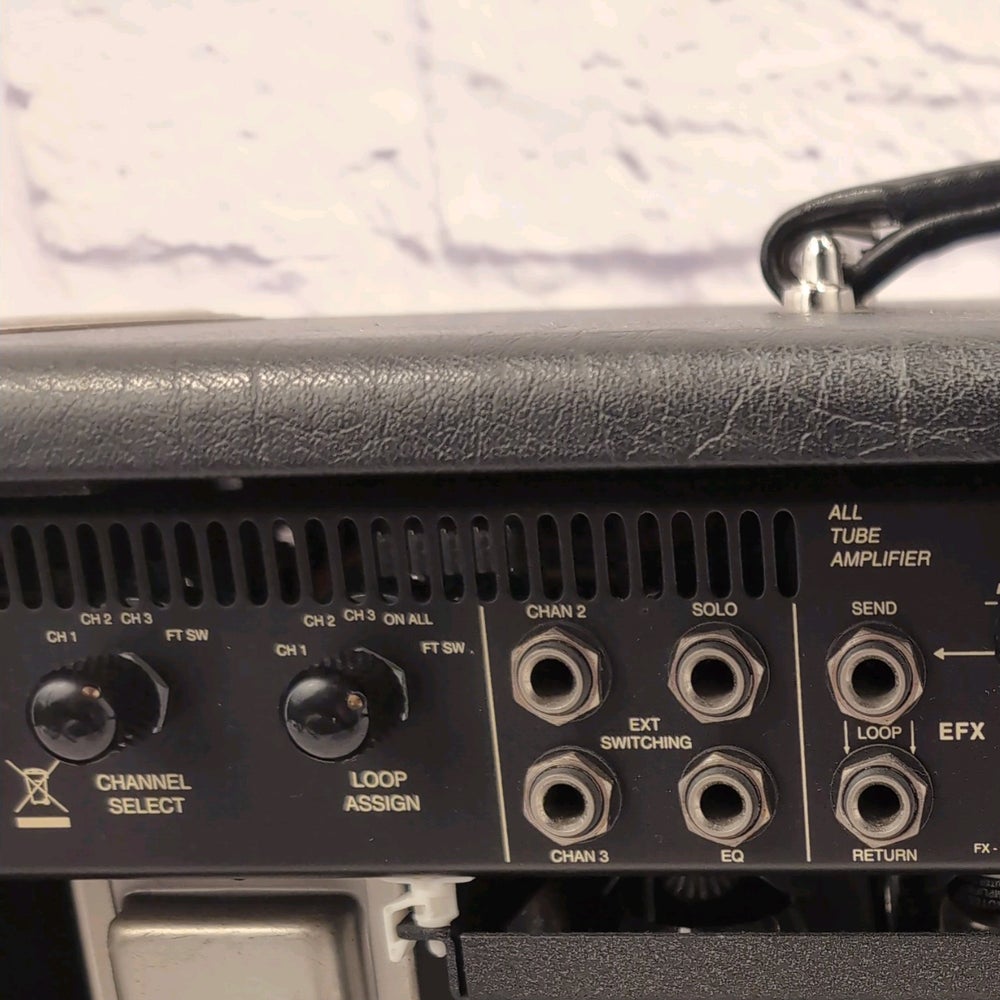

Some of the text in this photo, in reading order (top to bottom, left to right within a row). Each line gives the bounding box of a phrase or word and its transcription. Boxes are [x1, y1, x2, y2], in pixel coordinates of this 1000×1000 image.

[828, 504, 862, 520] ALL
[831, 528, 881, 544] TUBE
[830, 551, 931, 567] AMPLIFIER
[526, 605, 586, 618] CHAN 2
[692, 602, 737, 616] SOLO
[852, 601, 897, 615] SEND
[81, 613, 112, 625] CH 2
[121, 612, 153, 624] CH 3
[304, 615, 336, 627] CH 2
[344, 609, 376, 621] CH 3
[383, 613, 433, 625] ON ALL
[46, 631, 76, 643] CH 1
[166, 629, 208, 641] FT SW
[276, 644, 306, 656] CH 1
[422, 641, 465, 654] FT SW
[629, 718, 660, 731] EXT
[940, 722, 985, 740] EFX
[858, 726, 902, 740] LOOP
[601, 735, 692, 749] SWITCHING
[95, 774, 192, 791] CHANNEL
[350, 771, 407, 788] LOOP
[108, 797, 185, 814] SELECT
[344, 795, 420, 811] ASSIGN
[974, 843, 990, 853] FX
[550, 850, 609, 863] CHAN 3
[721, 850, 744, 862] EQ
[853, 849, 917, 862] RETURN
